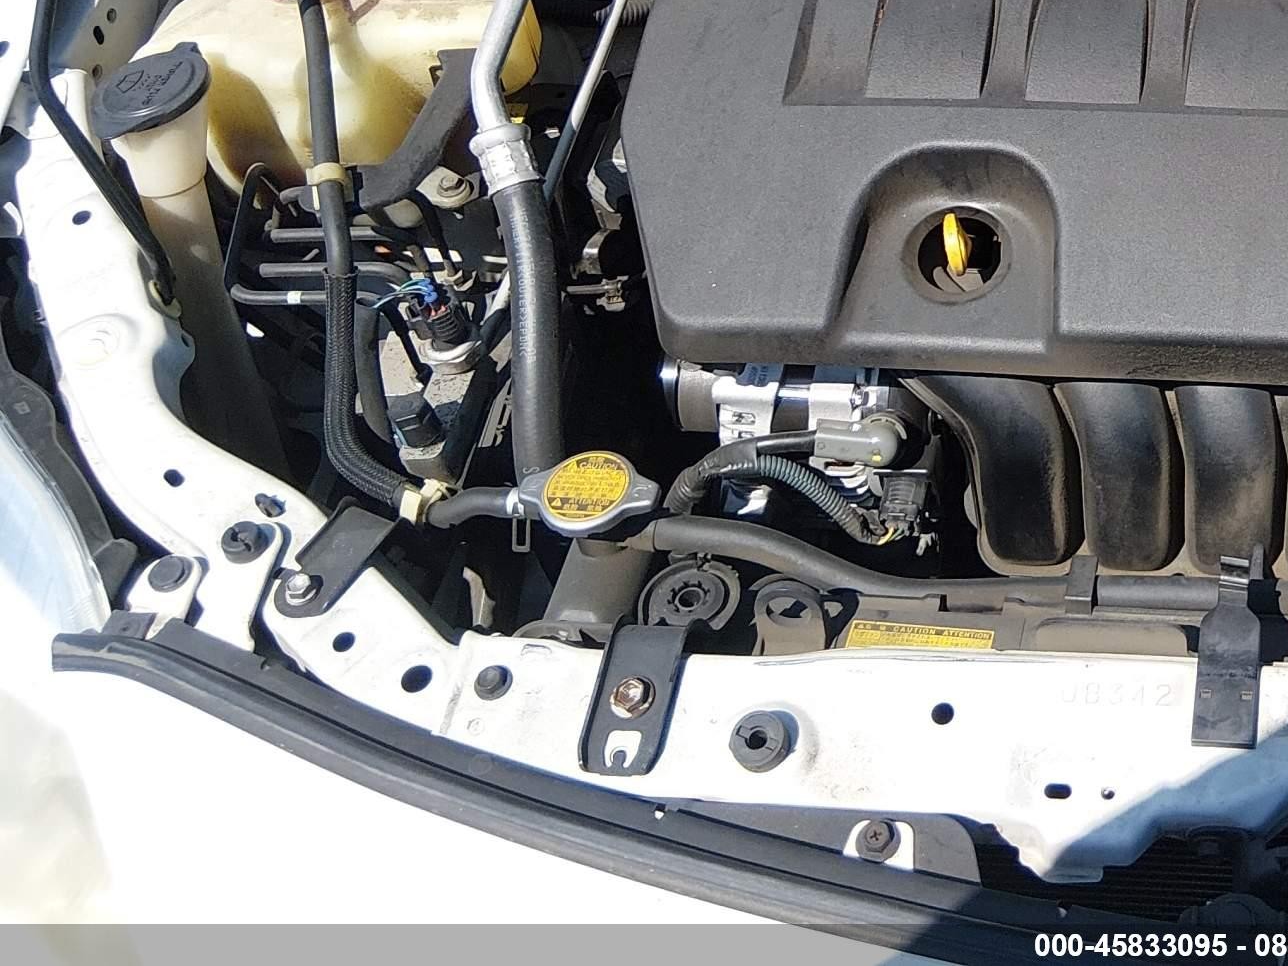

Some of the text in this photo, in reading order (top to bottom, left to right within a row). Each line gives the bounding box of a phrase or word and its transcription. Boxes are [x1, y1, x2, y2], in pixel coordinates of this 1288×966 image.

[579, 461, 618, 471] CAUTION
[893, 627, 936, 635] CAUTION
[943, 630, 990, 640] ATTENTION
